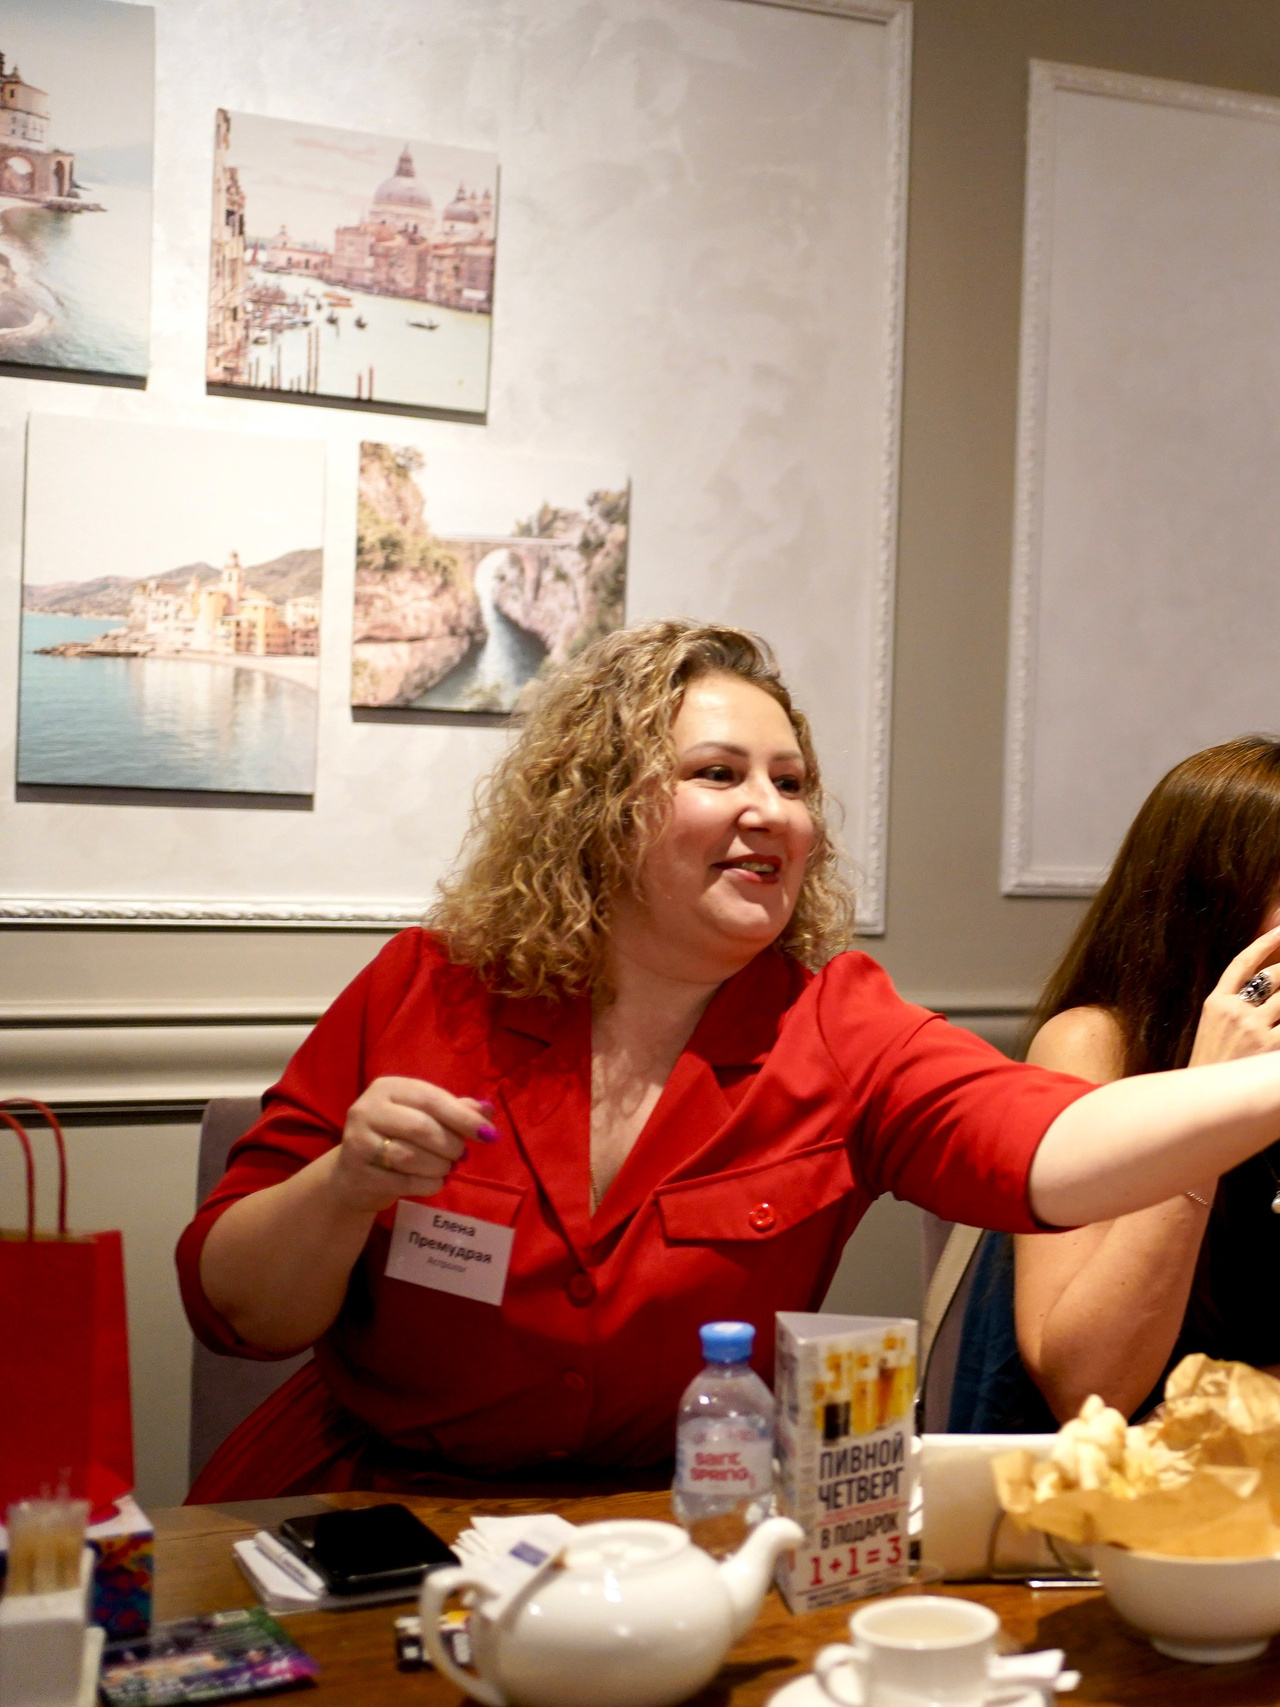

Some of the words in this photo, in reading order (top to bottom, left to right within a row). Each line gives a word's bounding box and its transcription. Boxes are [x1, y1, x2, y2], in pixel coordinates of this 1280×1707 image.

[432, 1214, 476, 1237] Елена
[408, 1231, 493, 1264] Премудрая
[819, 1431, 905, 1481] ПИВНОЙ
[818, 1466, 905, 1512] ЧЕТВЕРГ
[821, 1527, 832, 1549] В
[833, 1512, 898, 1546] ПОДАРОК
